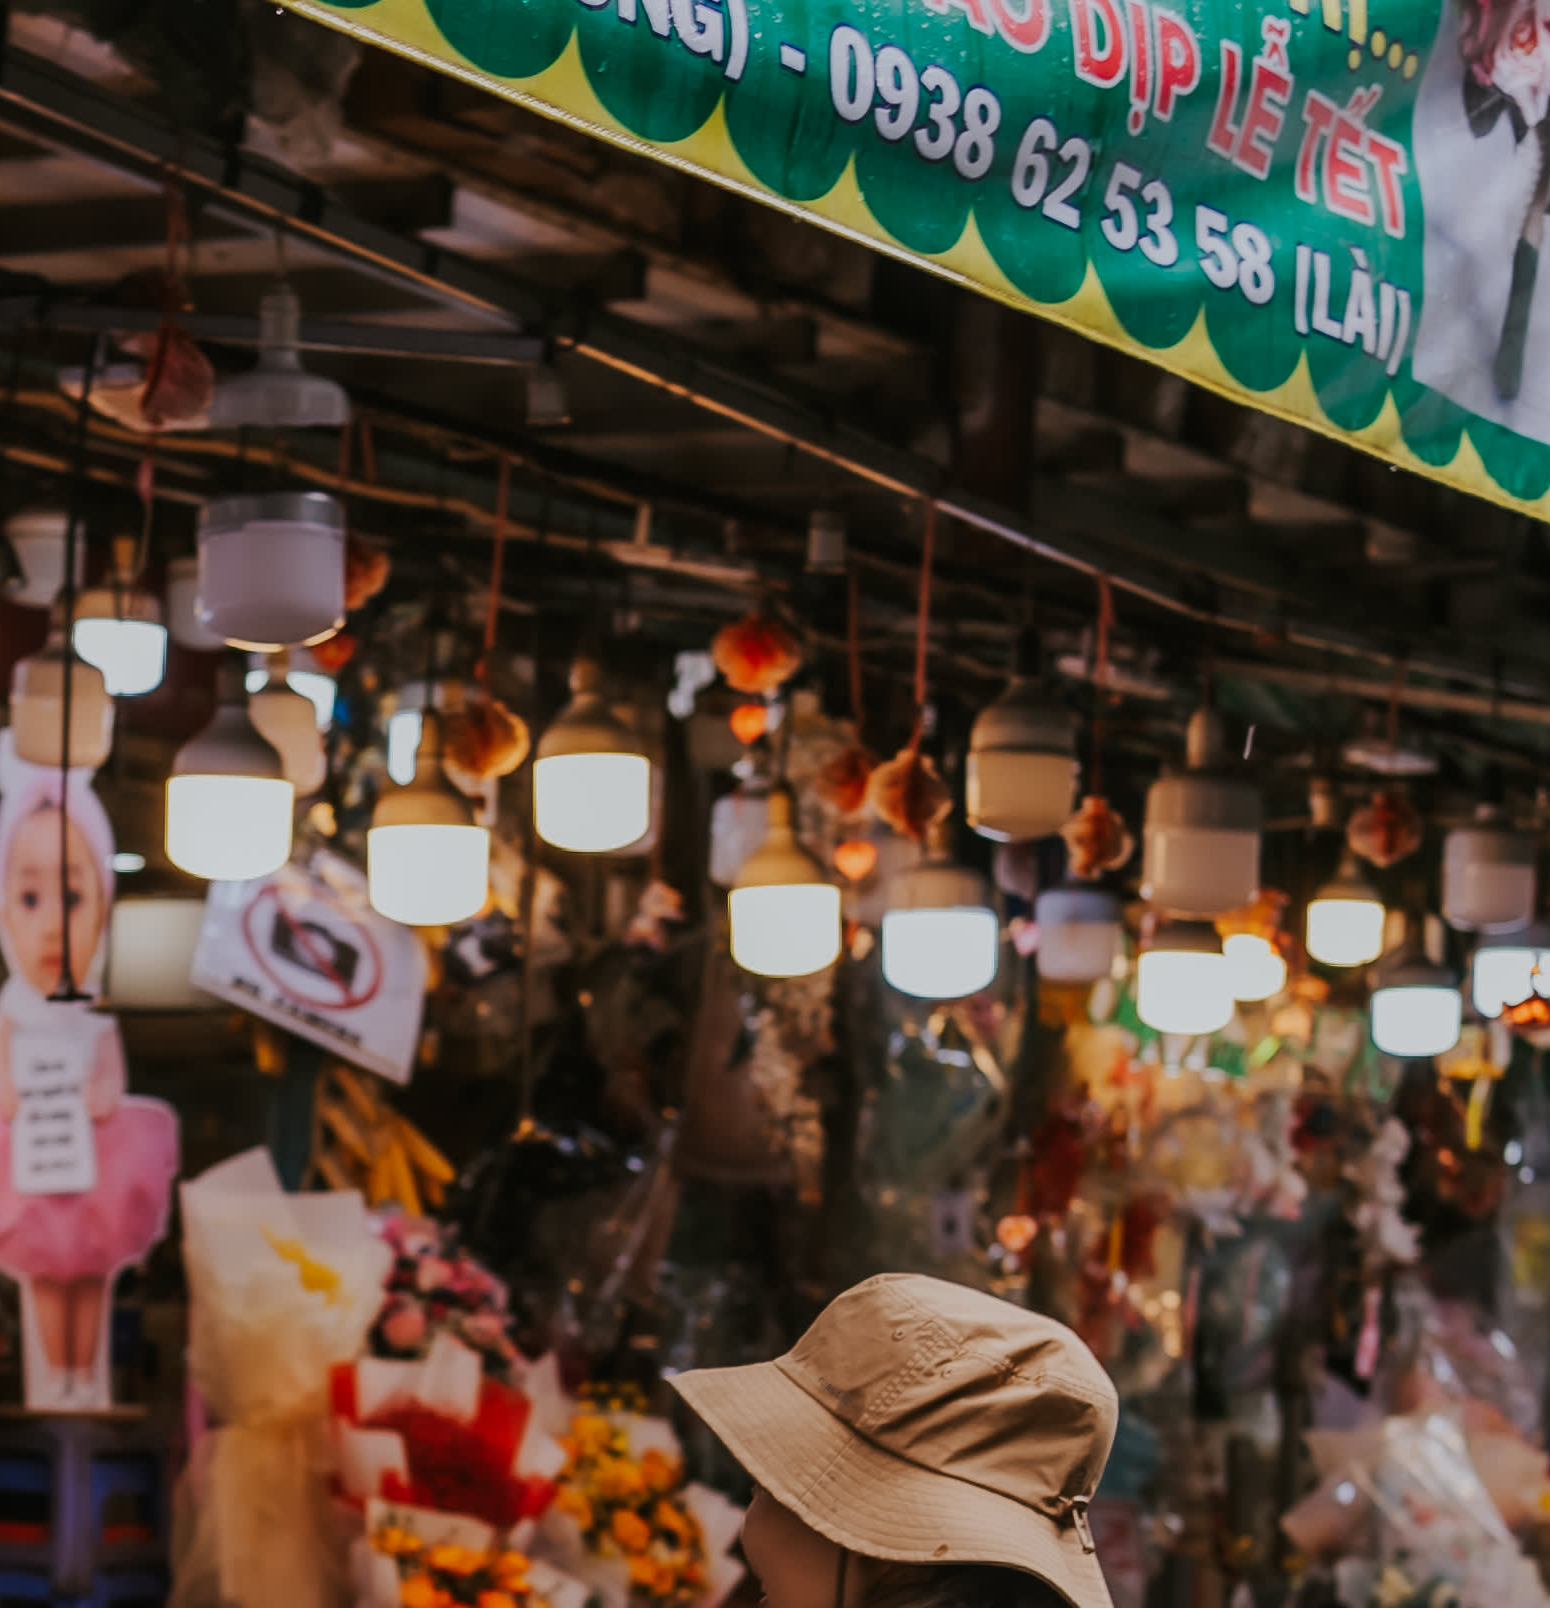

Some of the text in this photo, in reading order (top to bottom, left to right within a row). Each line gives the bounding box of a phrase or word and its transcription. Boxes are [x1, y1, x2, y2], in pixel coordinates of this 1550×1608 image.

[828, 22, 1002, 180] 0938
[1012, 116, 1092, 230] 62
[1101, 162, 1179, 267] 53
[1196, 204, 1275, 305] 58
[1295, 243, 1410, 377] (LÀI)
[1069, 0, 1201, 137] DỊP
[1207, 15, 1295, 181] LỄ
[1294, 84, 1407, 239] TẾT
